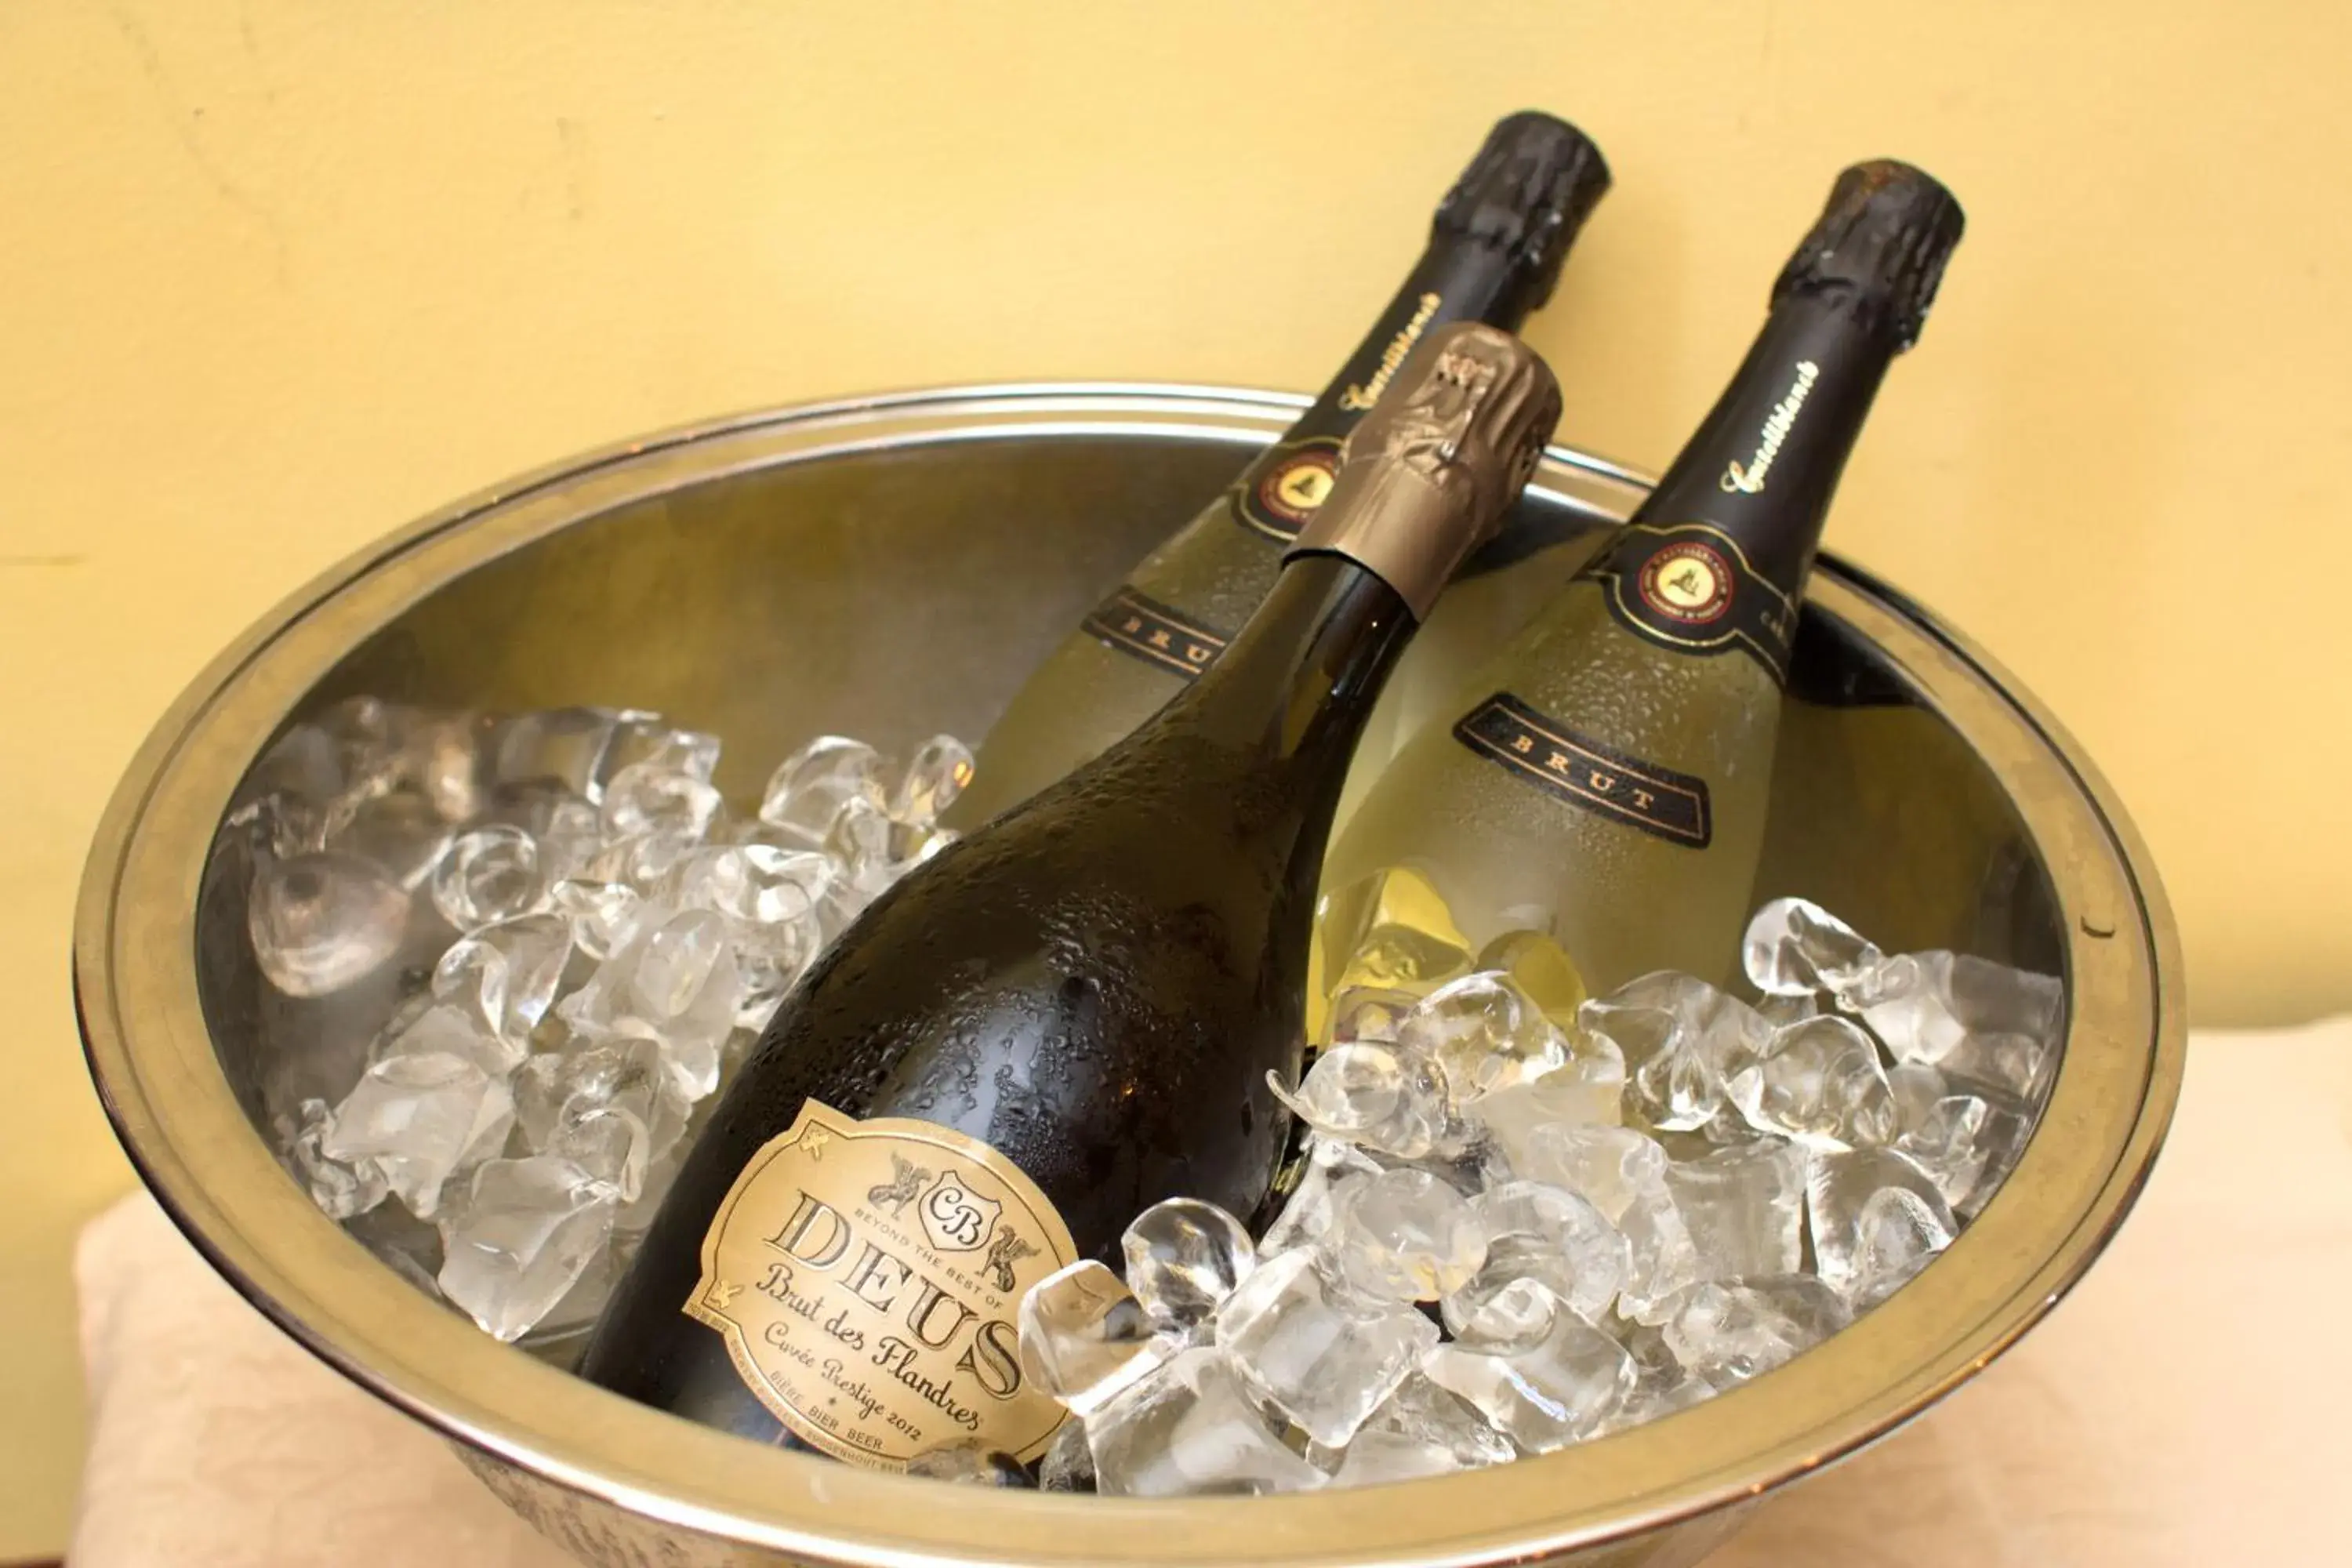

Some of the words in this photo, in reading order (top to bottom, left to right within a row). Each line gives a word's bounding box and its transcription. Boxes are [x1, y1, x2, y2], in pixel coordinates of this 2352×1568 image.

[1122, 615, 1212, 662] BRU
[1510, 735, 1655, 810] BRUT
[855, 1208, 910, 1246] BEYOND
[916, 1245, 943, 1266] THE
[946, 1267, 982, 1294] BEST
[985, 1296, 1004, 1309] OF
[930, 1186, 983, 1246] CB
[762, 1189, 1022, 1400] DEUS
[756, 1262, 824, 1322] Brut
[824, 1309, 865, 1351] des
[872, 1336, 979, 1431] Flandres
[764, 1321, 816, 1367] Cuvée
[821, 1359, 885, 1420] Prestige
[887, 1411, 923, 1441] 2012
[808, 1406, 839, 1431] BIER
[848, 1428, 884, 1450] BEER
